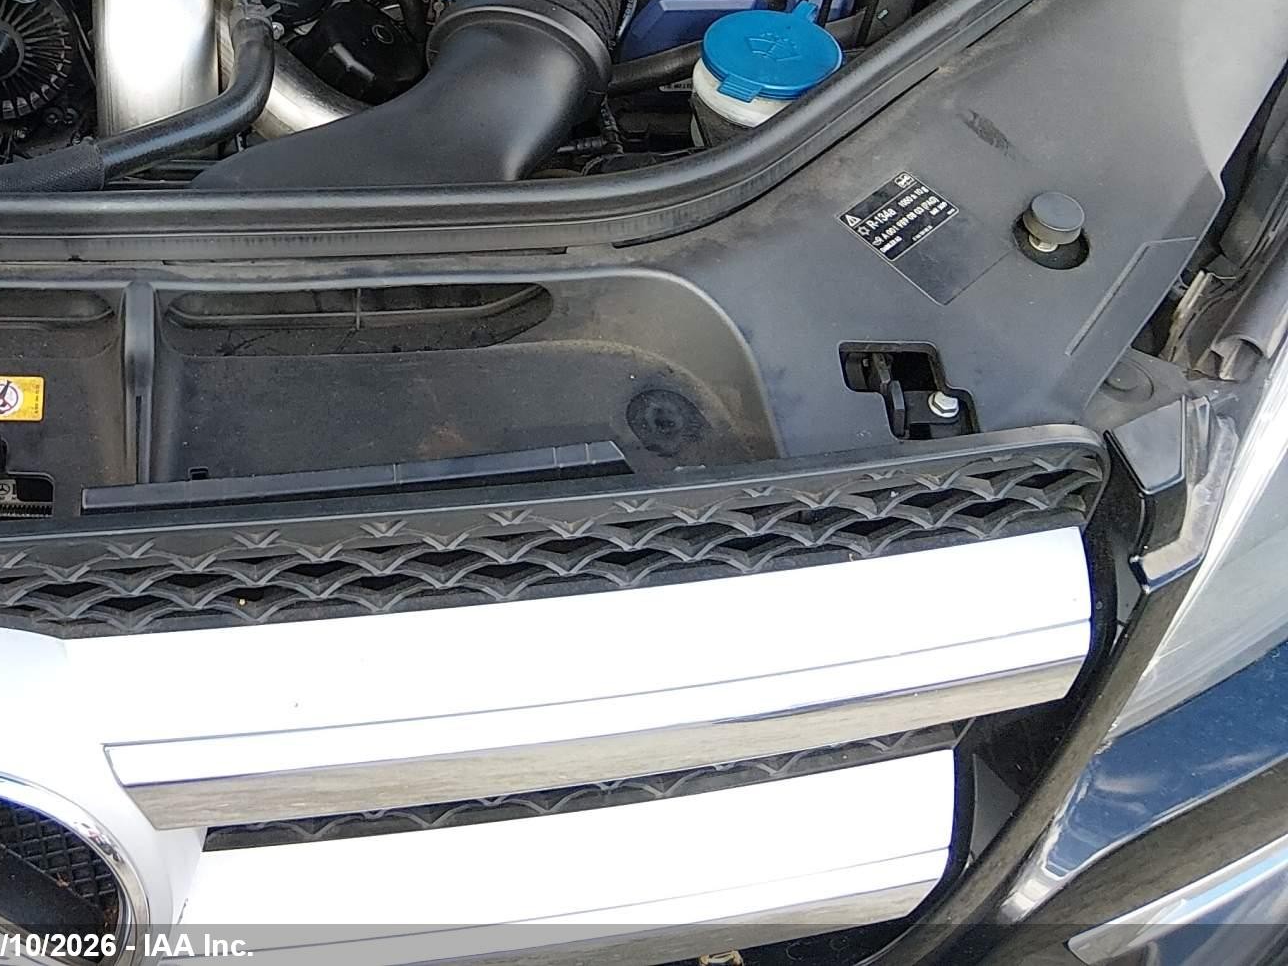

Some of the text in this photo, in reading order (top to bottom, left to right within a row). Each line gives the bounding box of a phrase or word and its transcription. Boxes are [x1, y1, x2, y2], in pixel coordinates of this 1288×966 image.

[866, 208, 897, 230] R-134a
[880, 232, 890, 240] A
[885, 225, 899, 236] 001
